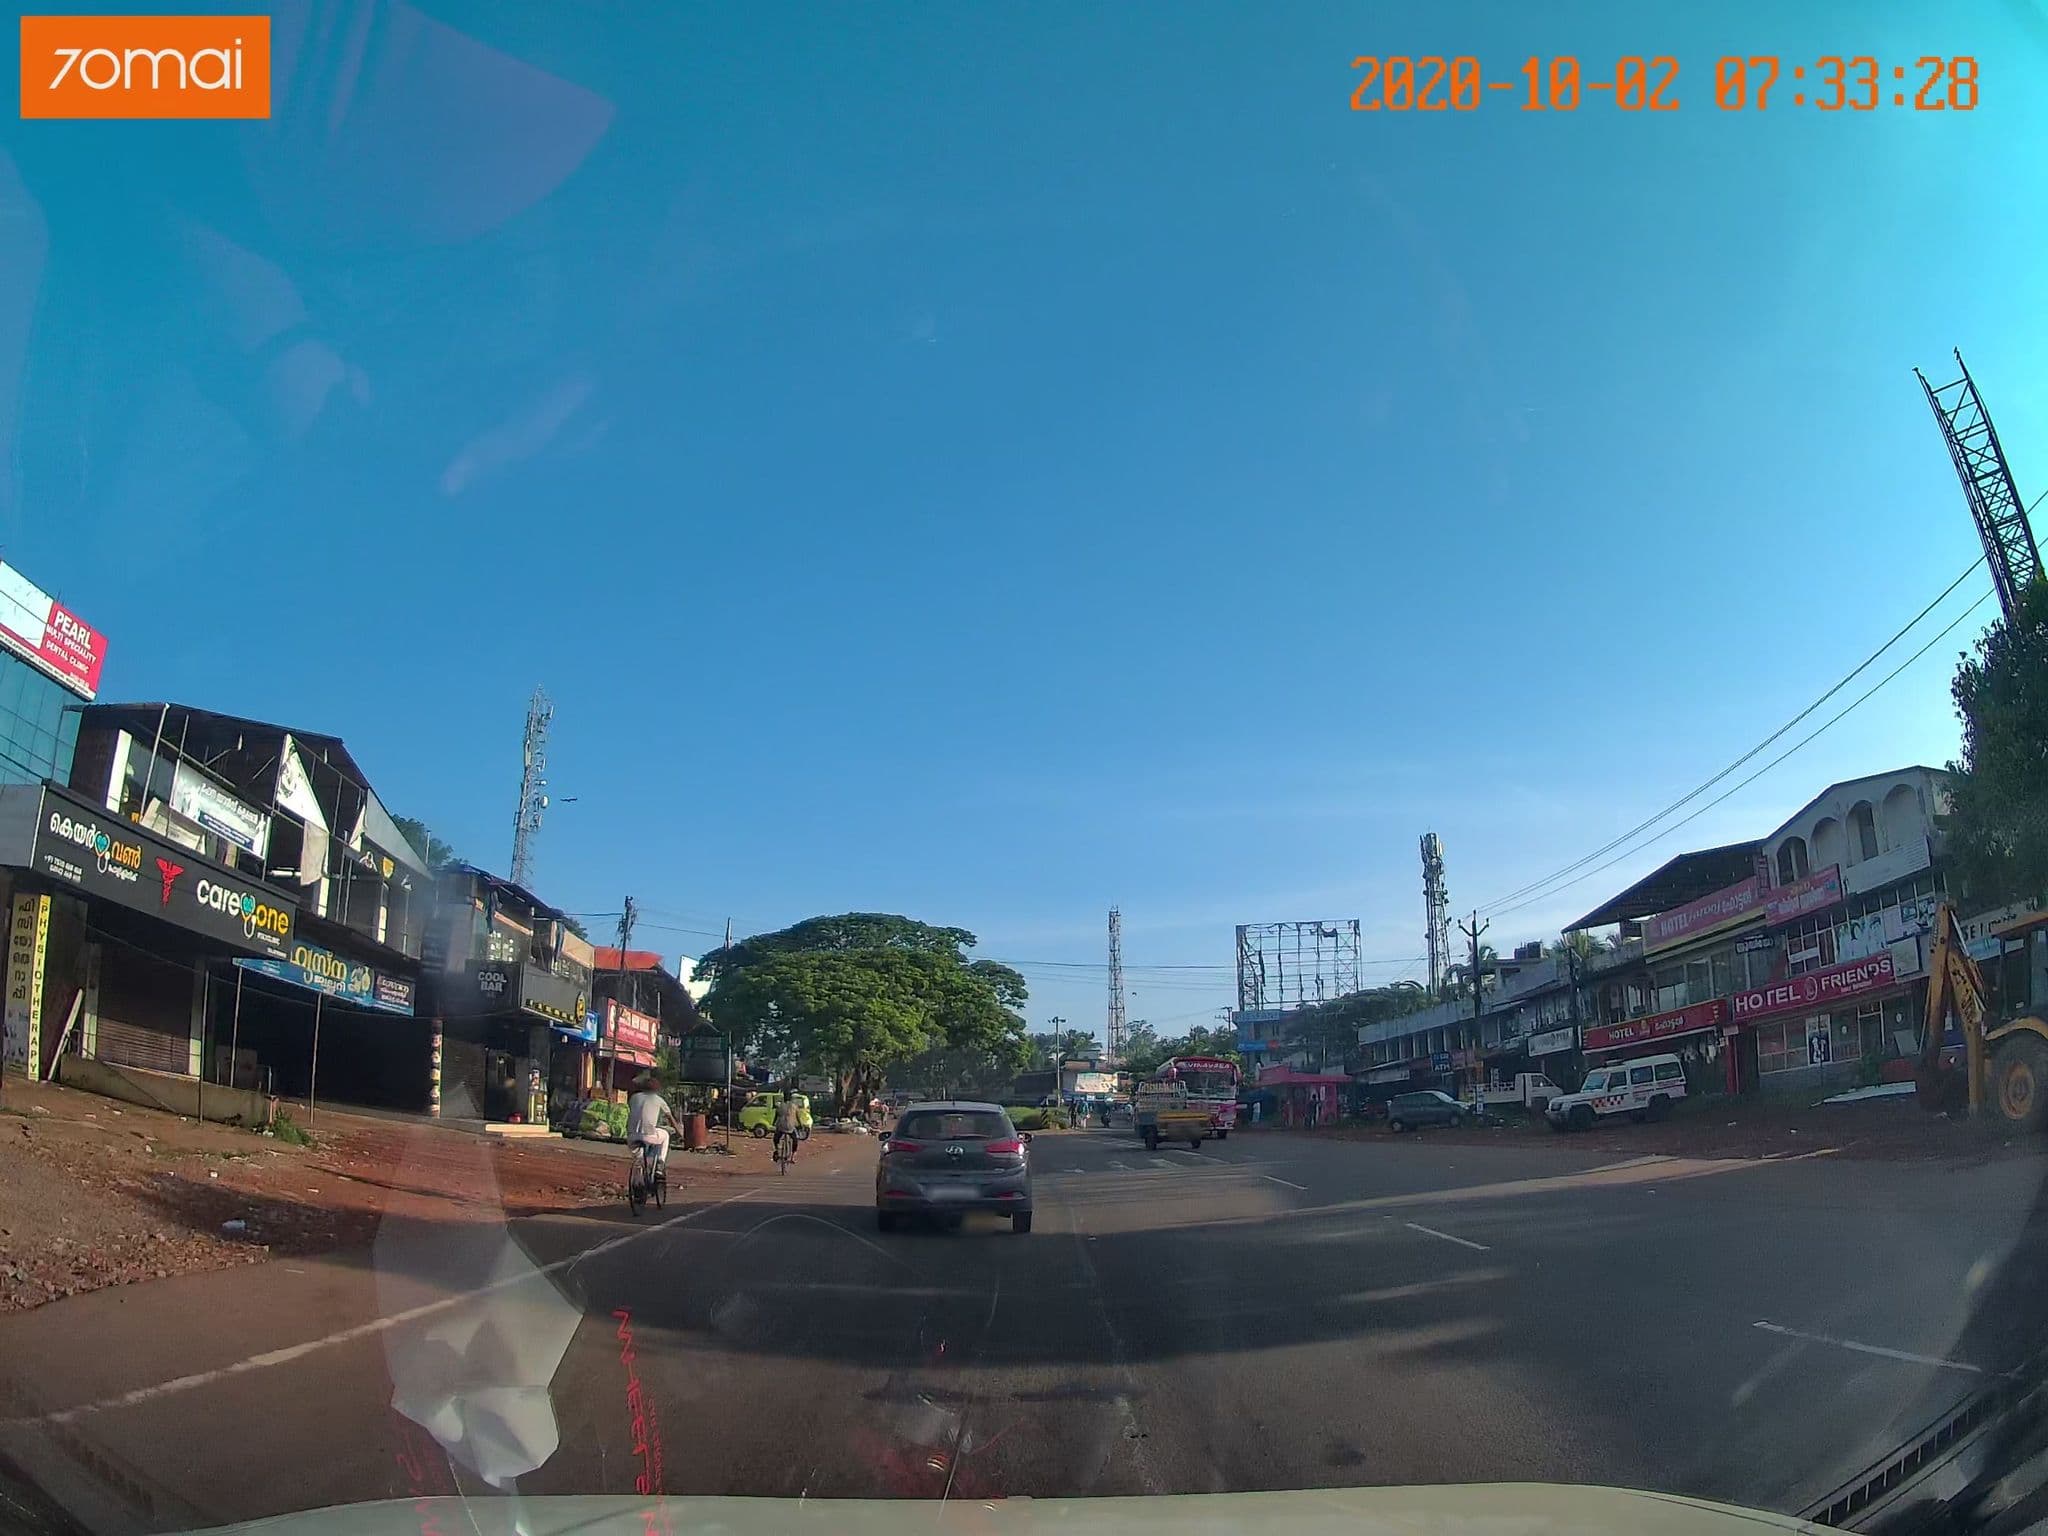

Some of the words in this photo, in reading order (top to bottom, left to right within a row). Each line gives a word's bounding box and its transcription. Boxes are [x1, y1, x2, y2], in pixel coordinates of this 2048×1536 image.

[54, 609, 92, 651] PEARL
[45, 639, 69, 661] DENTAL
[196, 879, 241, 917] care
[256, 903, 289, 935] one
[29, 904, 50, 1073] PHYSIOTHERAPY
[478, 971, 507, 983] COOL
[480, 981, 503, 992] BAR
[1735, 985, 1801, 1013] HOTEL
[1821, 959, 1891, 991] FRIENDS
[1608, 1027, 1635, 1041] HOTEL
